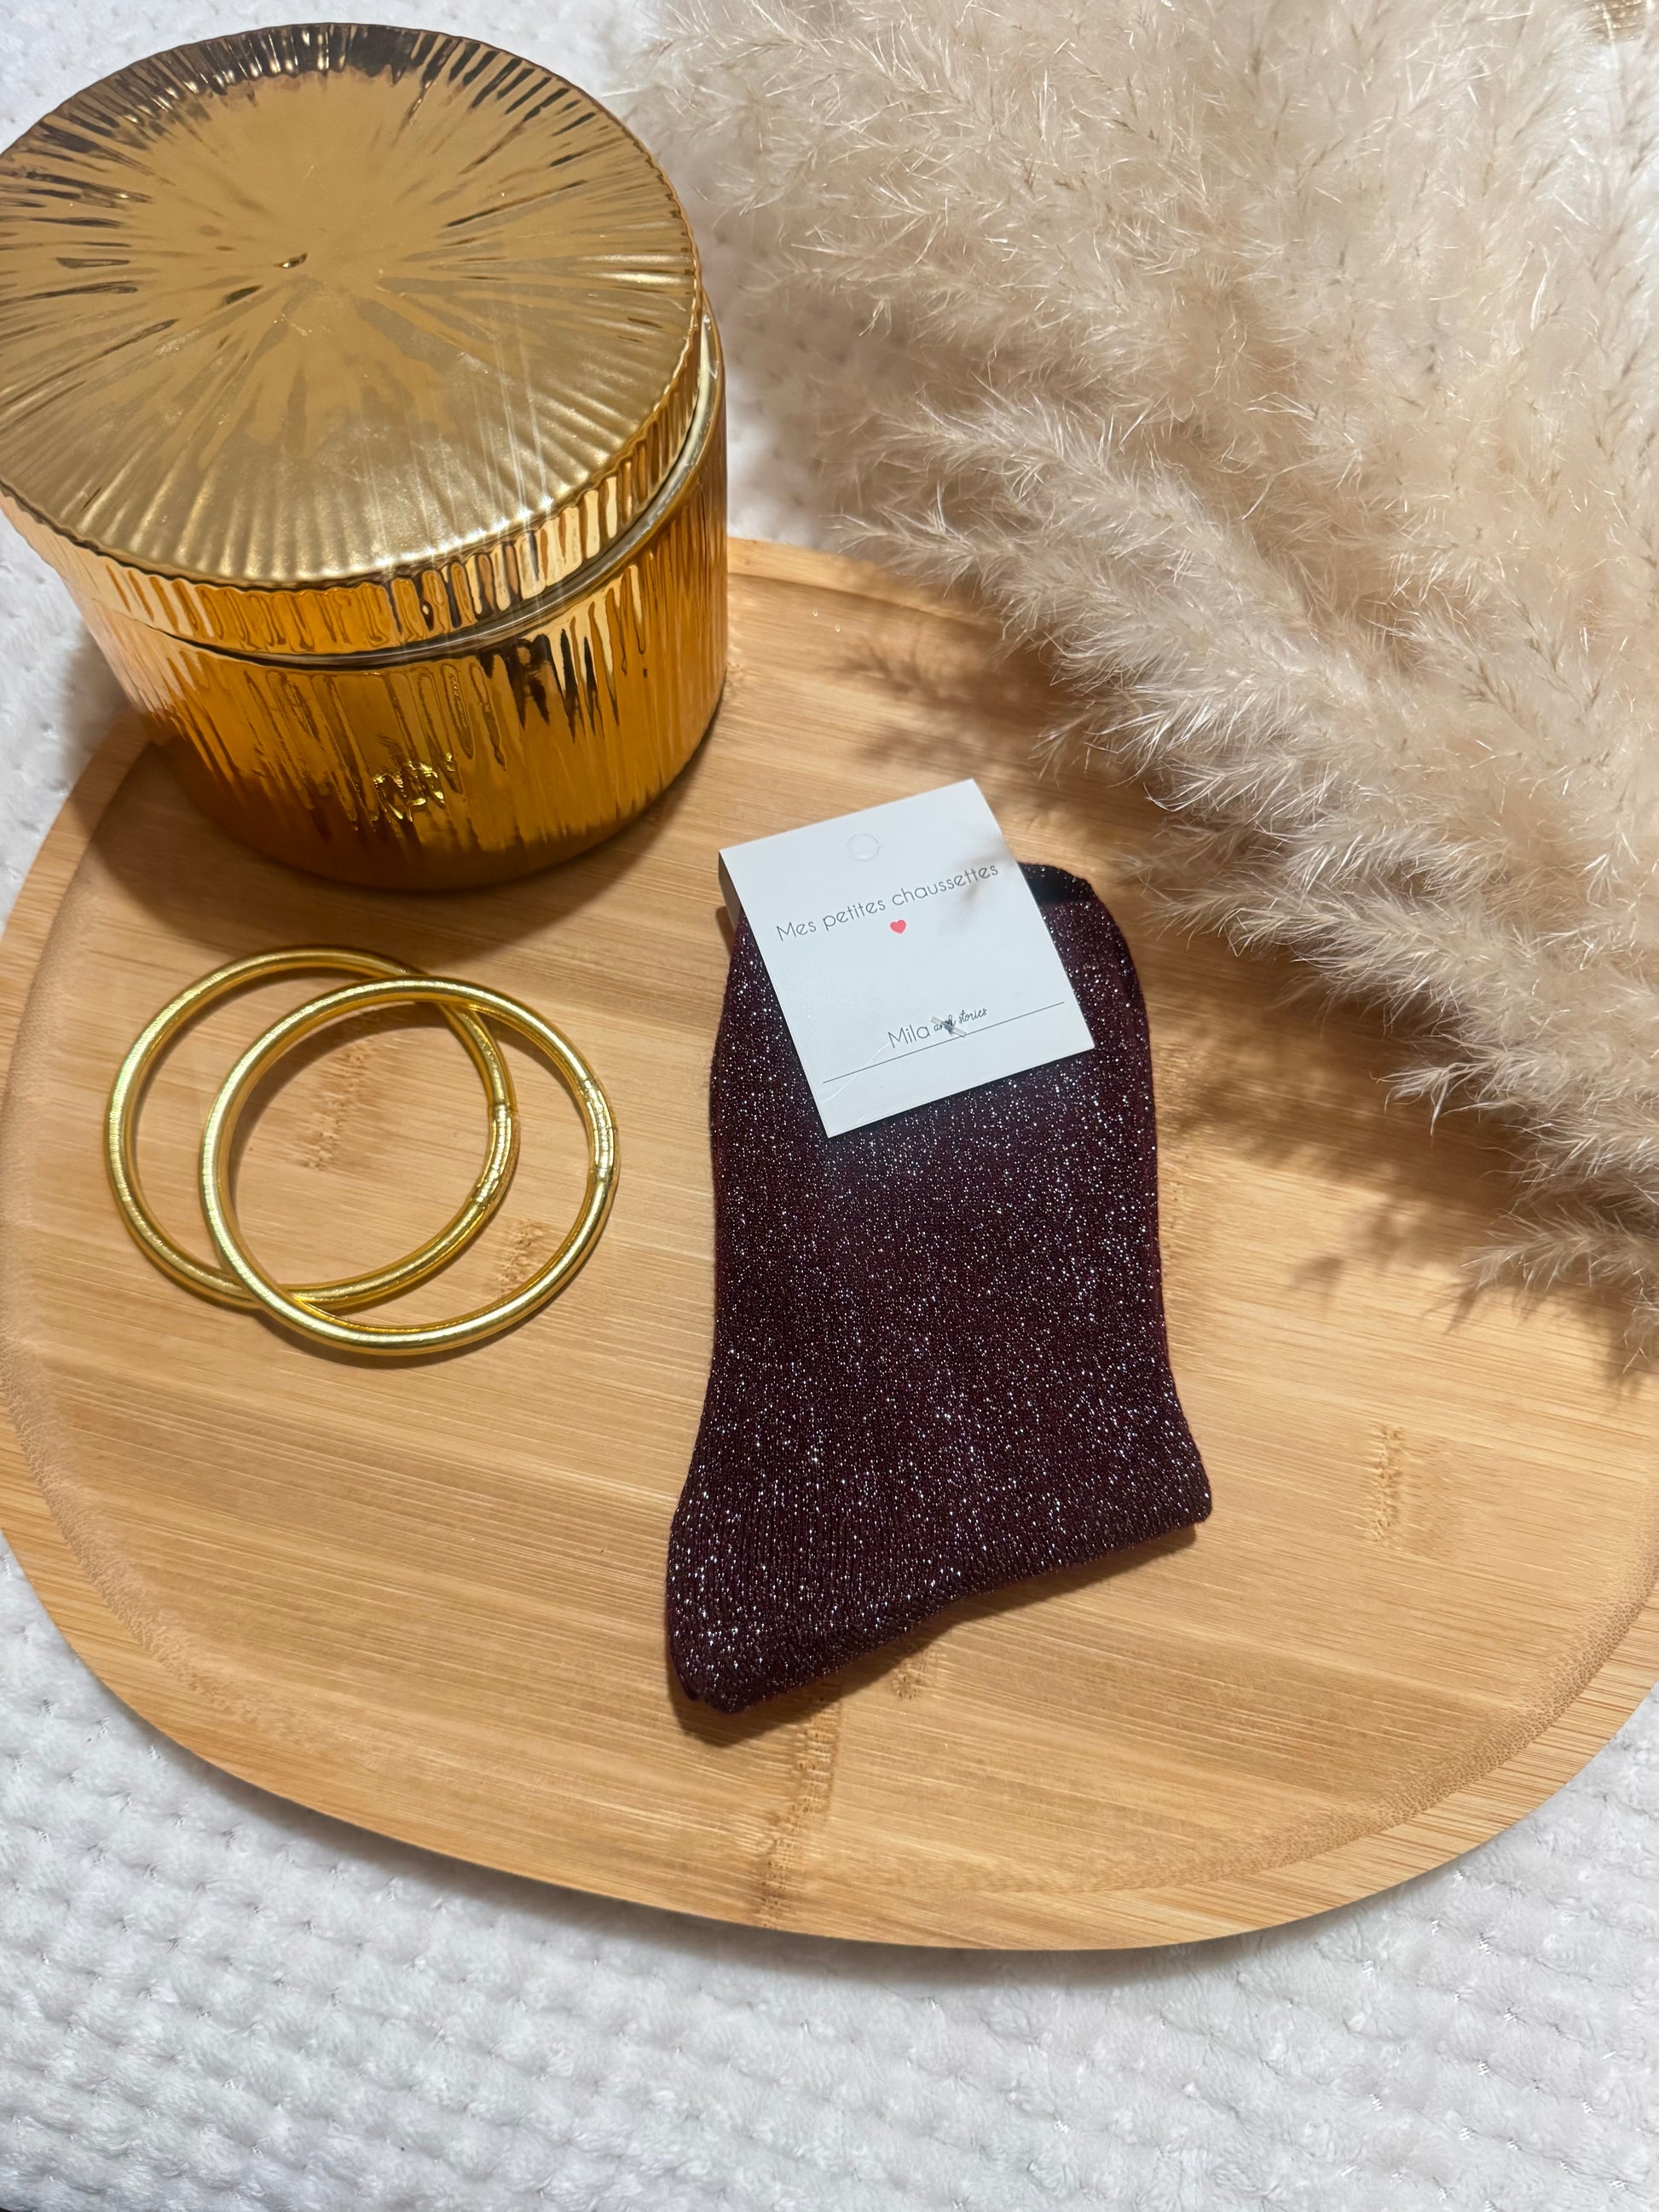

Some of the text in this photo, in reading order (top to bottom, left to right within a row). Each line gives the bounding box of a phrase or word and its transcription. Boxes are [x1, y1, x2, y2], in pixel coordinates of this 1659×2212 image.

[776, 864, 999, 942] Mes petites chaussettes
[887, 1024, 931, 1048] Mila
[957, 1008, 988, 1025] stories
